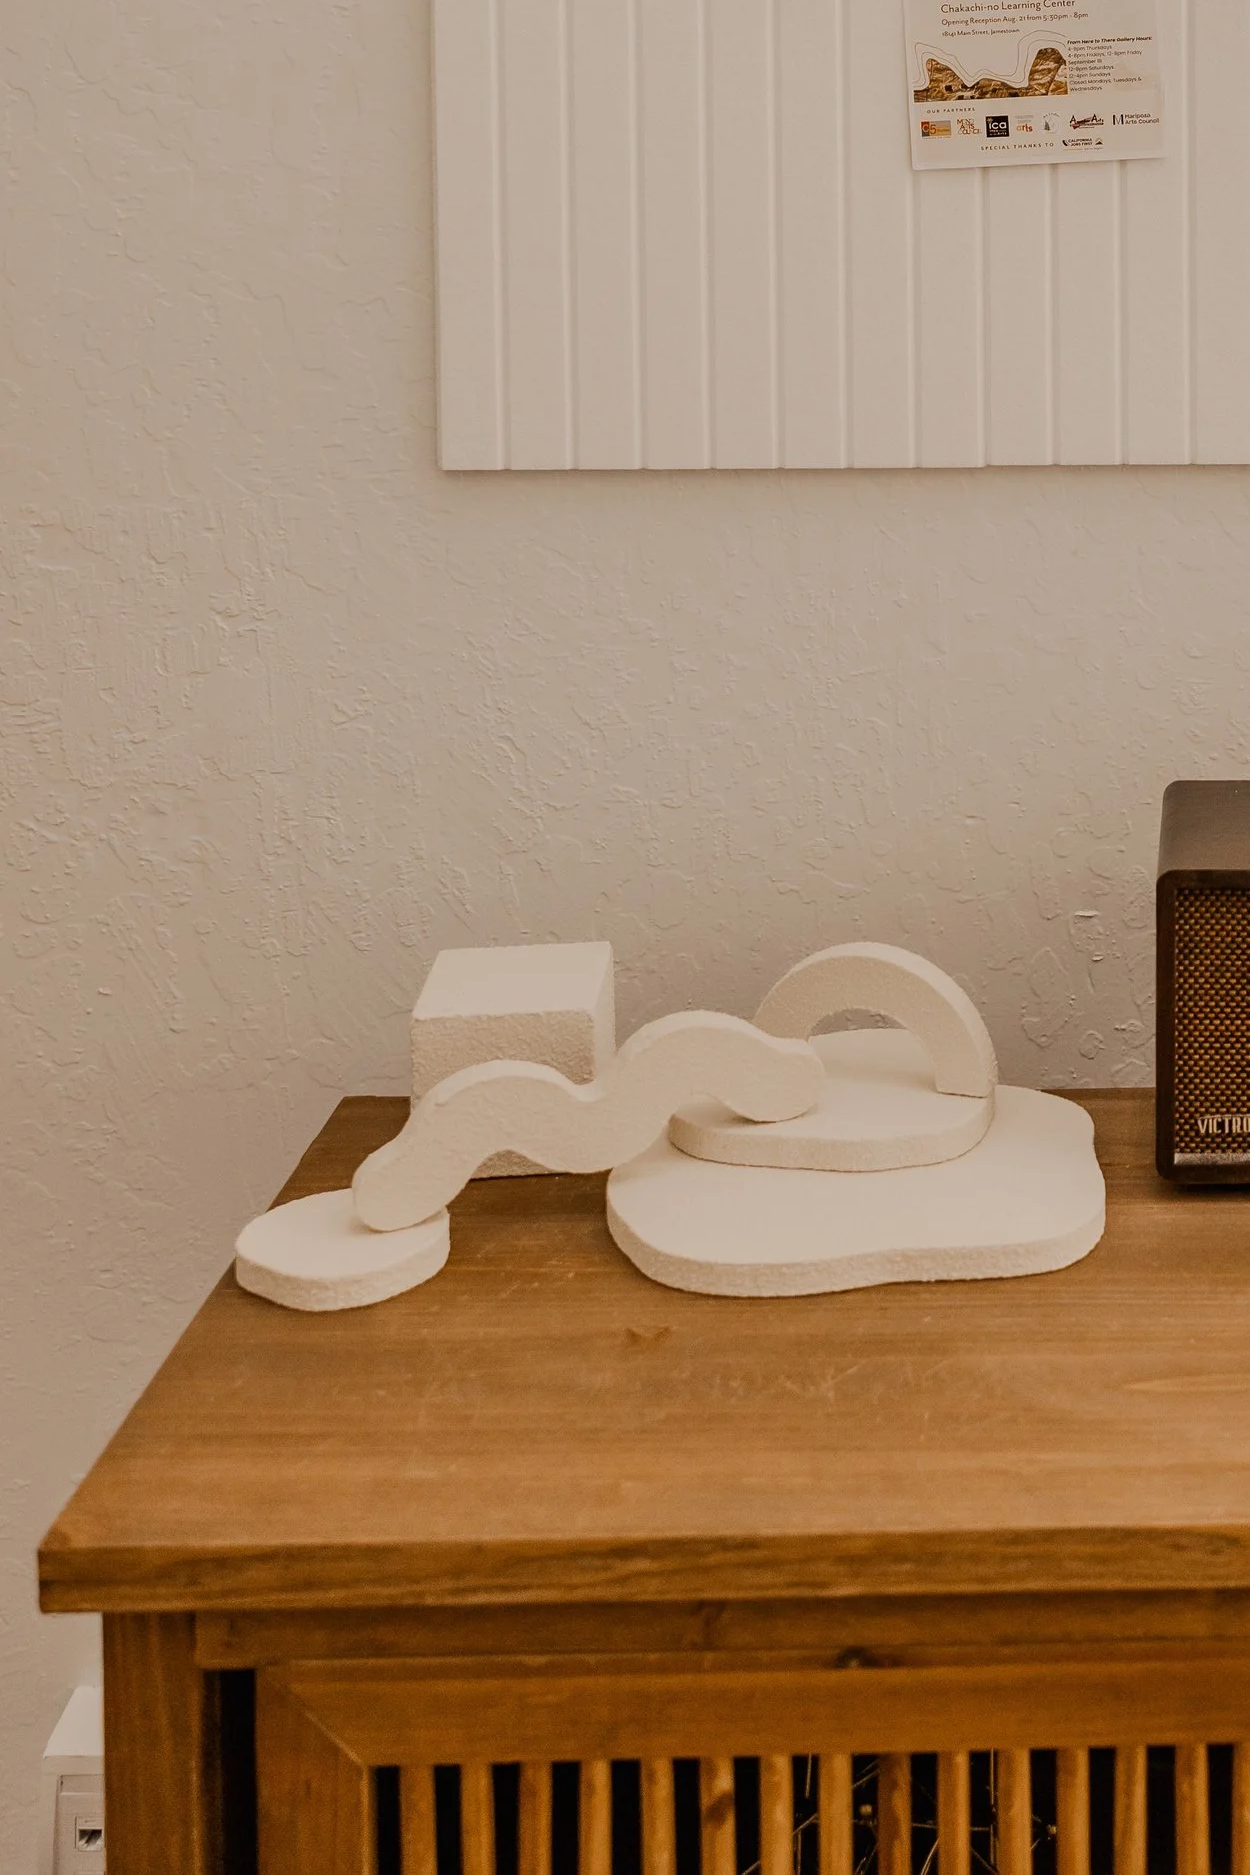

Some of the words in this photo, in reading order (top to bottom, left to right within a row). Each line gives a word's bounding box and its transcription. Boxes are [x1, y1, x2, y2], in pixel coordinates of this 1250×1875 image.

[941, 3, 999, 14] Chakachi-no
[1001, 1, 1041, 11] Learning
[1016, 124, 1033, 133] arts
